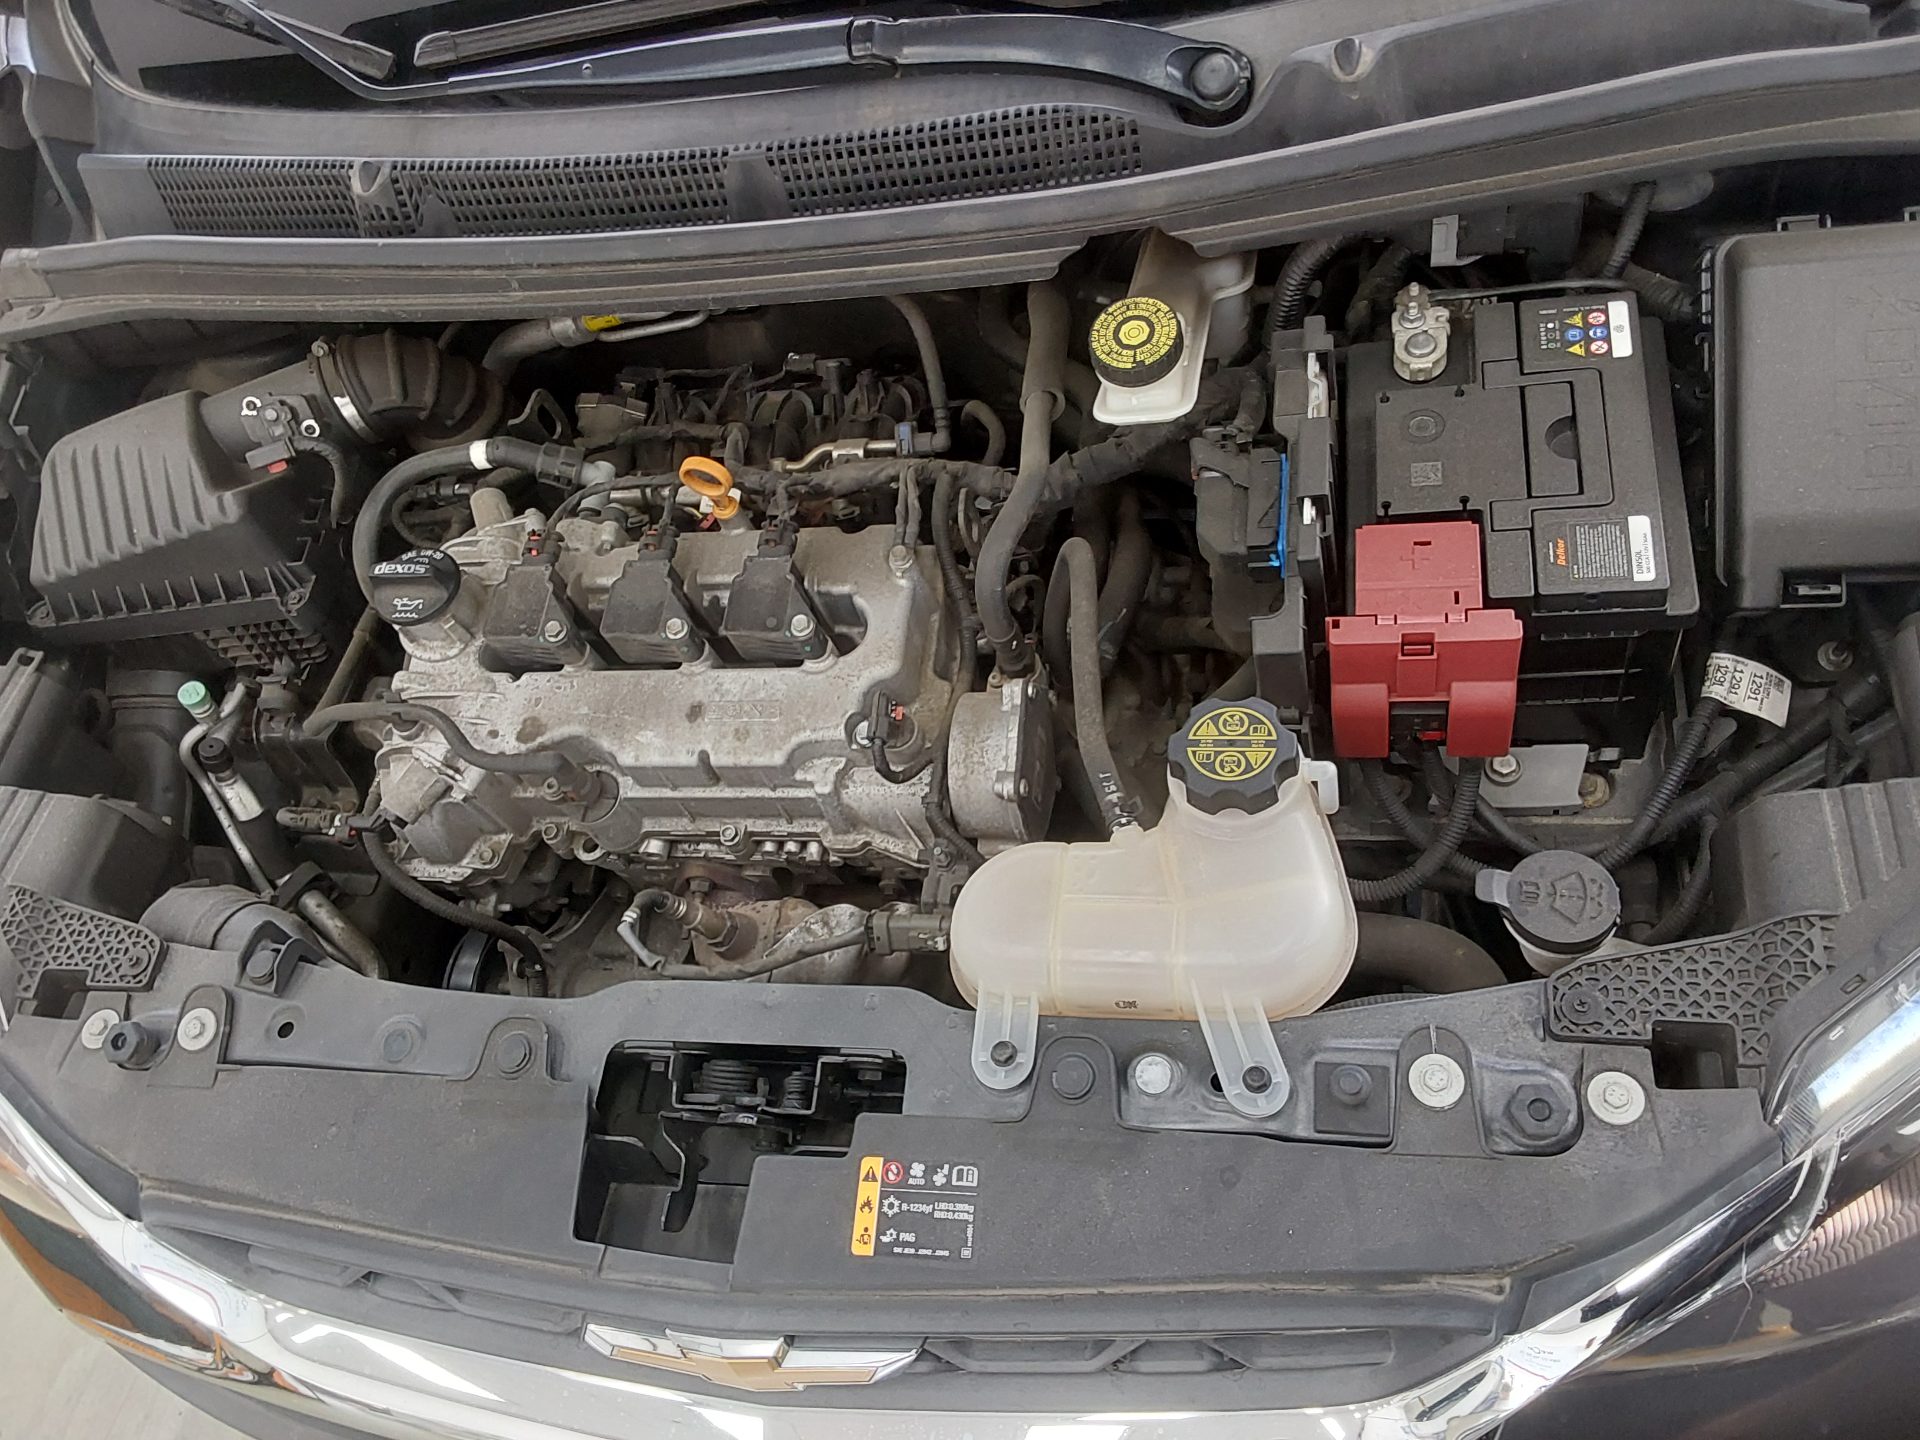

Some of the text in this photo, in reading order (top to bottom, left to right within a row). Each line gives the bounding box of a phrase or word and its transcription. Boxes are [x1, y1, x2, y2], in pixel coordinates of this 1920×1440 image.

[1091, 330, 1099, 342] CAP
[402, 550, 417, 560] SAE
[1556, 538, 1566, 566] Delkor
[374, 561, 426, 574] dexos
[1712, 663, 1730, 688] 1291
[1730, 667, 1745, 696] 1291
[1747, 672, 1764, 702] 1291
[907, 1178, 926, 1186] AUTO
[901, 1203, 934, 1214] R-1234yf
[899, 1232, 916, 1243] PAG
